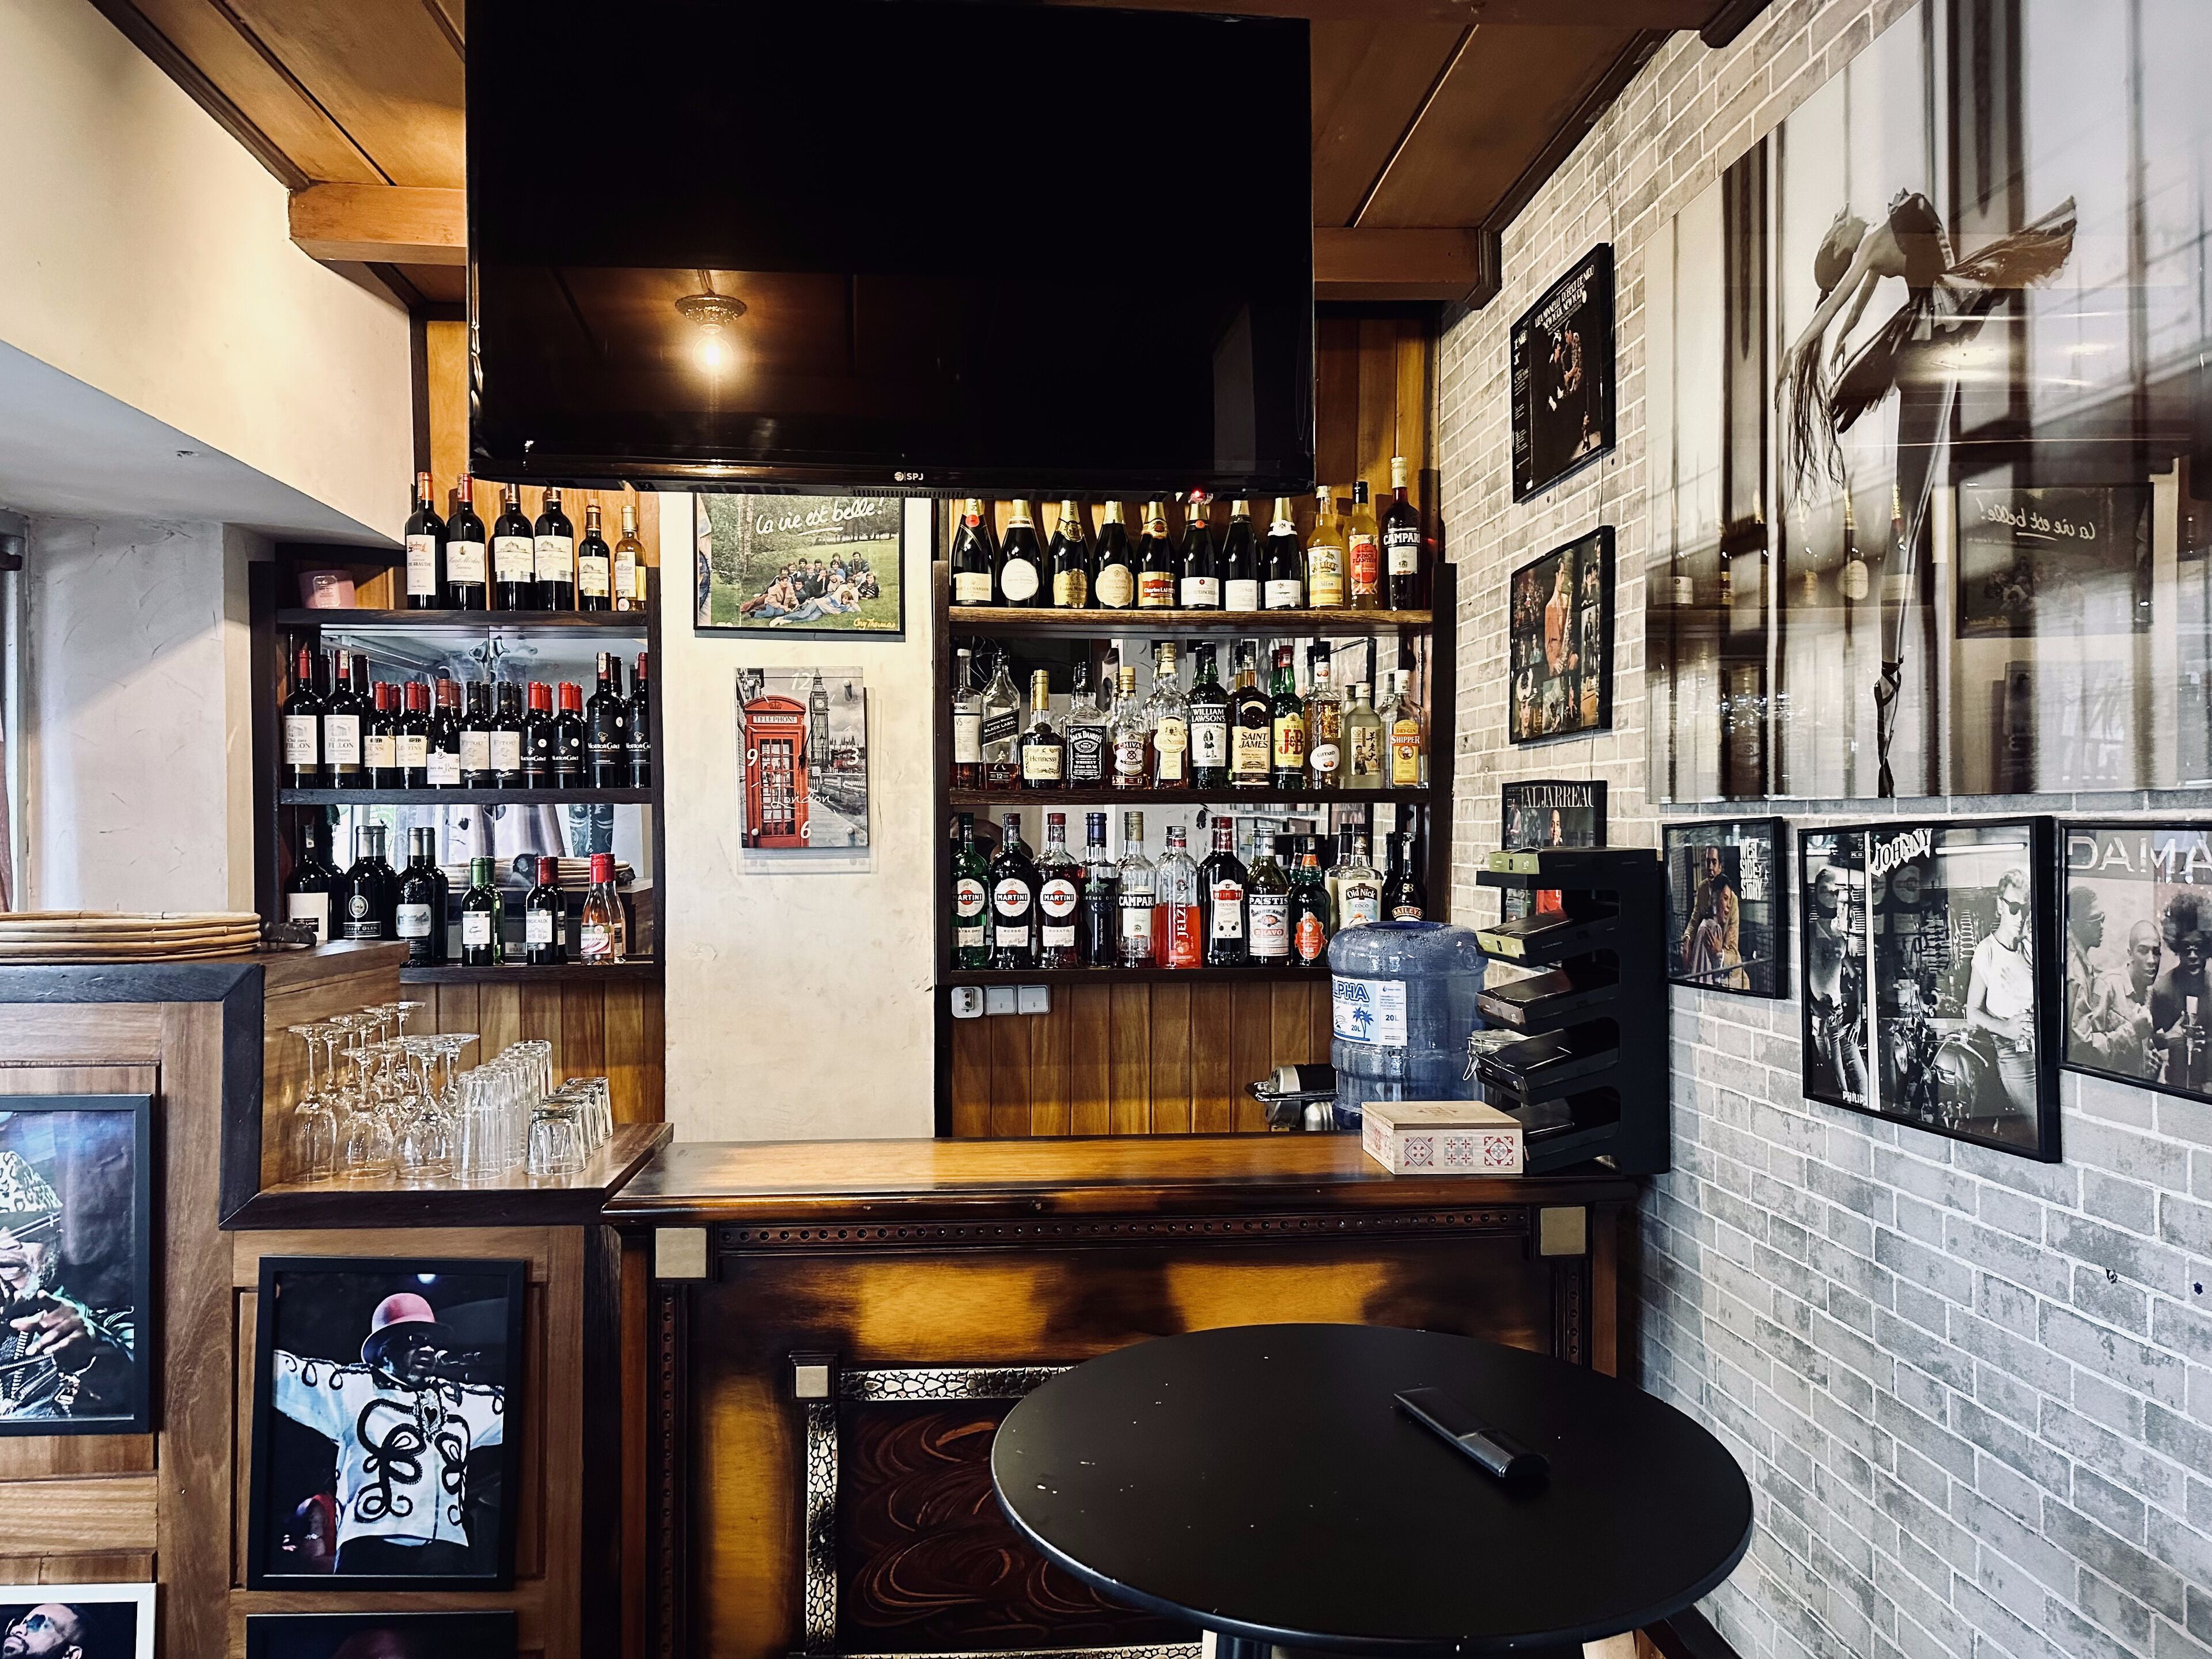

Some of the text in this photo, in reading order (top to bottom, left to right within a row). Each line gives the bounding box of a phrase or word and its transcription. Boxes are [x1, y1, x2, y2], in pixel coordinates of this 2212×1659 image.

[907, 472, 924, 481] SPJ
[778, 511, 802, 532] vie
[805, 505, 829, 527] est
[1383, 532, 1421, 546] CAMPARI
[791, 672, 812, 691] 12
[755, 715, 797, 723] TELEPHONE
[983, 725, 1001, 733] BLACK
[1001, 720, 1017, 728] LABEL
[1069, 732, 1083, 744] JACK
[1238, 740, 1268, 748] JAMES
[1241, 732, 1267, 741] SAINT
[1278, 729, 1304, 755] J&B
[1391, 735, 1421, 744] SHIPPER
[747, 748, 759, 767] 9
[847, 748, 859, 766] 3
[770, 783, 835, 810] London
[1524, 785, 1540, 808] AL
[800, 821, 812, 839] 6
[1739, 838, 1760, 859] WEST
[1875, 829, 1930, 870] JOHNNY
[1740, 858, 1759, 879] SIDE
[1346, 888, 1376, 899] Old Nick
[1740, 878, 1763, 900] STORY
[1119, 896, 1155, 907] CAMPARI
[1249, 897, 1289, 906] PASTIS
[1177, 893, 1190, 938] JELZIN
[1393, 907, 1423, 916] BAILEYS
[1351, 1024, 1361, 1032] 20L
